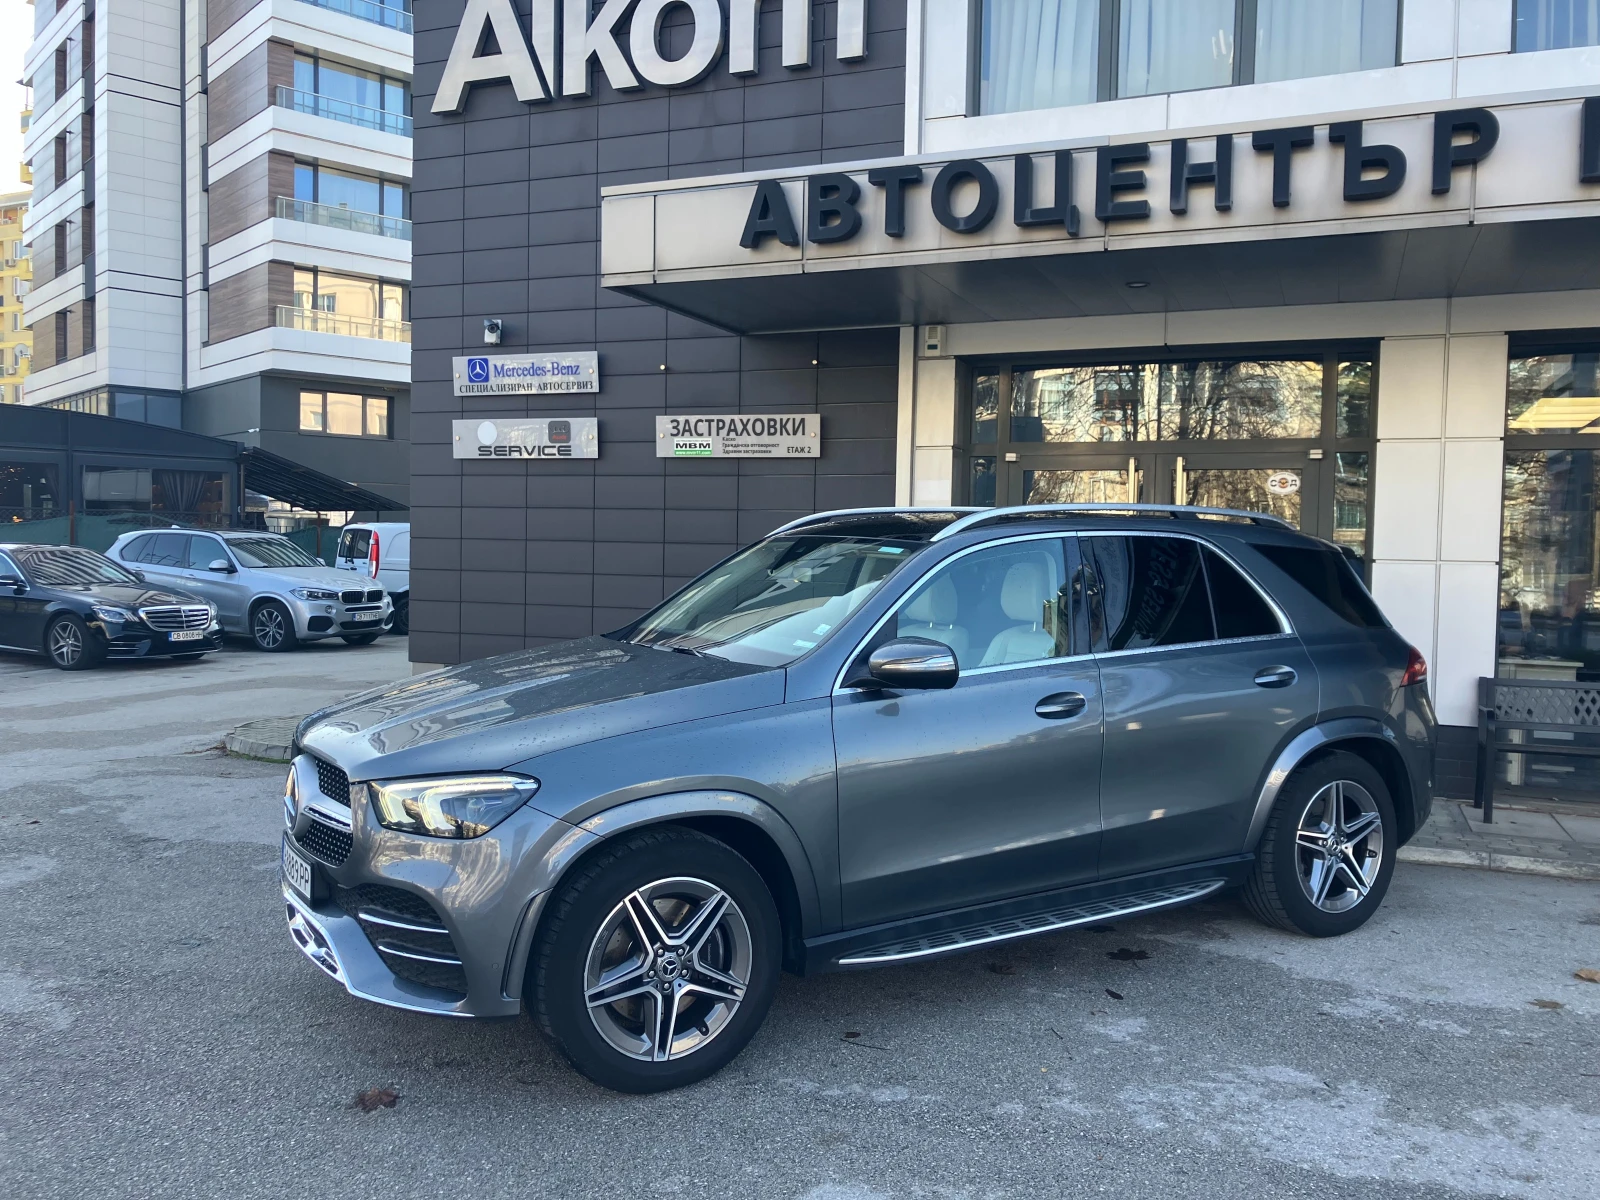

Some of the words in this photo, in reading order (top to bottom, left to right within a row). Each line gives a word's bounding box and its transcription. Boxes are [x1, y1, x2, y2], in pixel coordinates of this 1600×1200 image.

[739, 107, 1499, 249] АВТОЦЕНТЪР
[493, 361, 581, 378] Mercedes-Benz
[459, 383, 533, 394] СПЕЦИАЛИЗИРАН
[537, 381, 593, 391] АВТОСЕРВИЗ
[670, 417, 806, 437] ЗАСТРАХОВКИ
[478, 445, 572, 457] SERVICE
[787, 446, 805, 454] ЕТАЖ
[807, 446, 812, 454] 2
